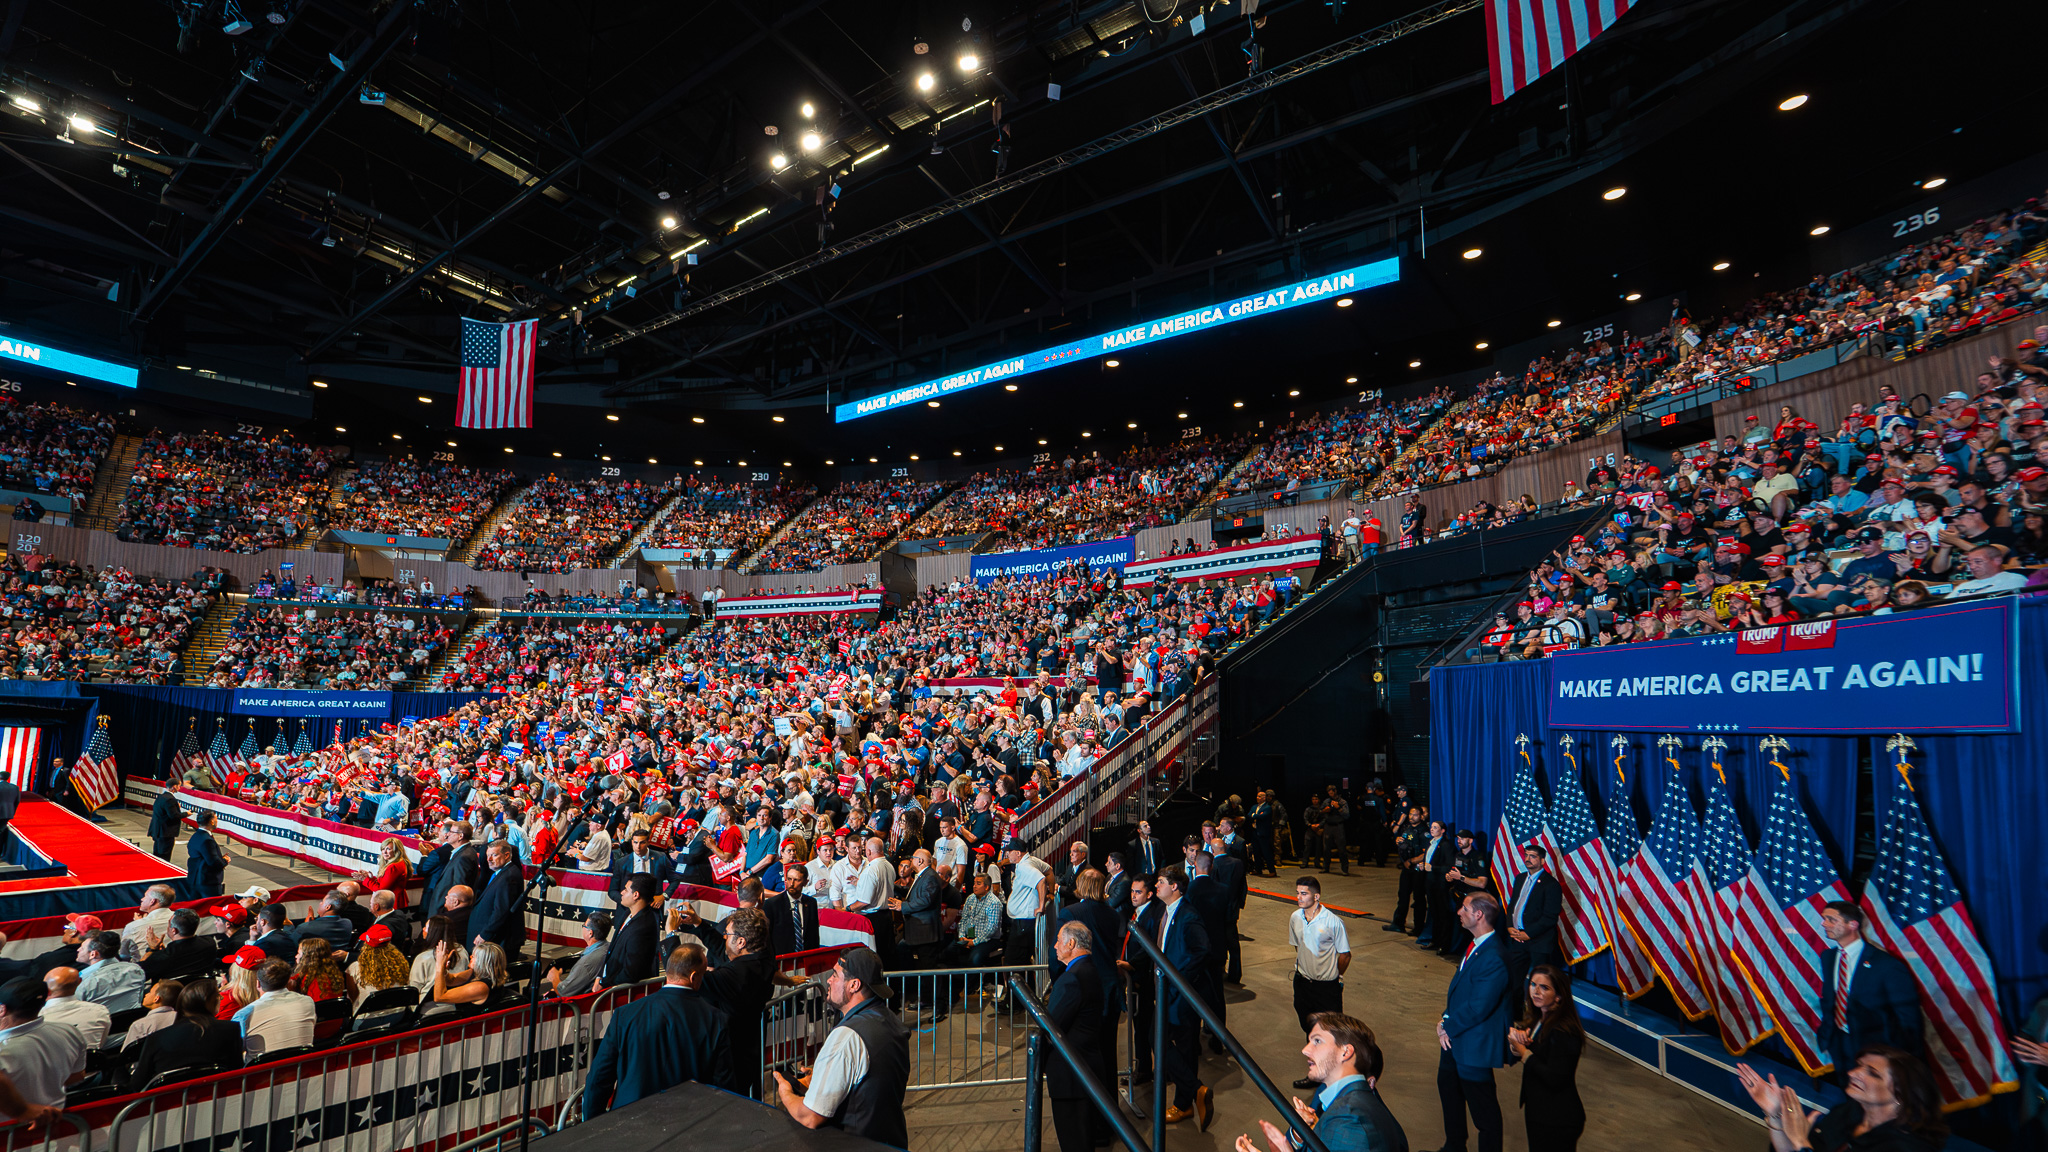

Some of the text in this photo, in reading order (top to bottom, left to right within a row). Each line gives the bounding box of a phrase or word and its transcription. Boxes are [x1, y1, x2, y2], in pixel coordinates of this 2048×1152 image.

[1893, 207, 1941, 238] 236
[1102, 273, 1354, 349] MAKE AMERICA GREAT AGAIN
[1583, 324, 1614, 344] 235
[857, 359, 1024, 414] MAKE AMERICA GREAT AGAIN
[1358, 388, 1383, 403] 234
[1660, 412, 1676, 427] EXIT
[237, 423, 263, 435] 227
[1182, 426, 1201, 439] 233
[433, 451, 454, 462] 228
[1033, 452, 1050, 463] 232
[1589, 453, 1615, 470] 16
[601, 467, 620, 476] 229
[751, 472, 769, 481] 230
[892, 468, 909, 477] 231
[18, 533, 41, 543] 120
[1004, 562, 1049, 577] AMERICA
[1088, 552, 1128, 567] AGAIN!
[1559, 653, 1983, 698] MAKE AMERICA GREAT AGAIN!
[239, 698, 269, 706] MAKE
[271, 699, 316, 707] AMERICA
[317, 700, 351, 708] GREAT
[608, 750, 626, 771] 47
[651, 818, 665, 843] DRAIN
[661, 820, 673, 845] SWAMP
